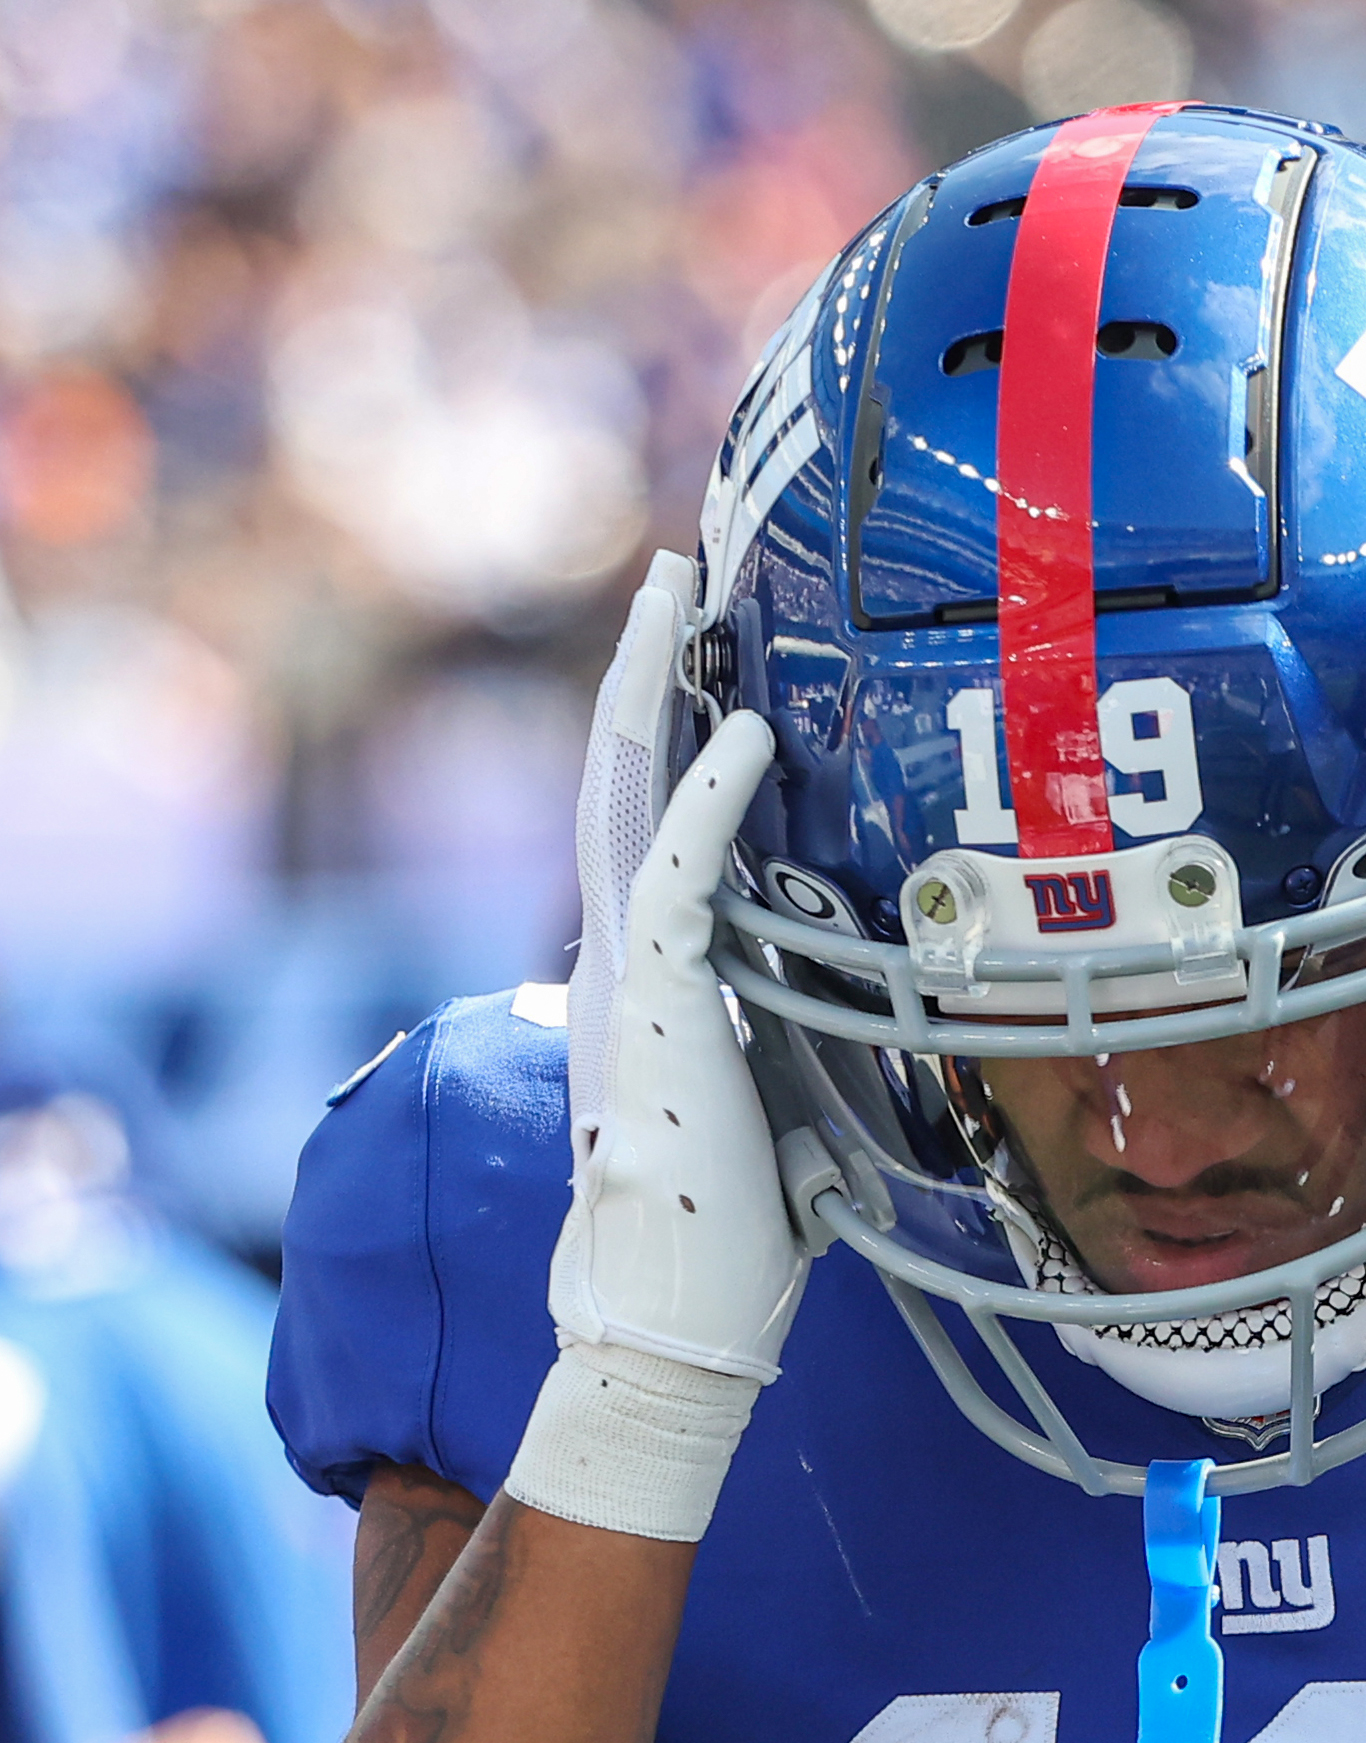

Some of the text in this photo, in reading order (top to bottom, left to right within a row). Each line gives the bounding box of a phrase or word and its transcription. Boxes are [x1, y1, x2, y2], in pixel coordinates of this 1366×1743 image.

[946, 676, 1204, 844] 19
[1023, 869, 1117, 933] ny
[1217, 1534, 1336, 1636] ny
